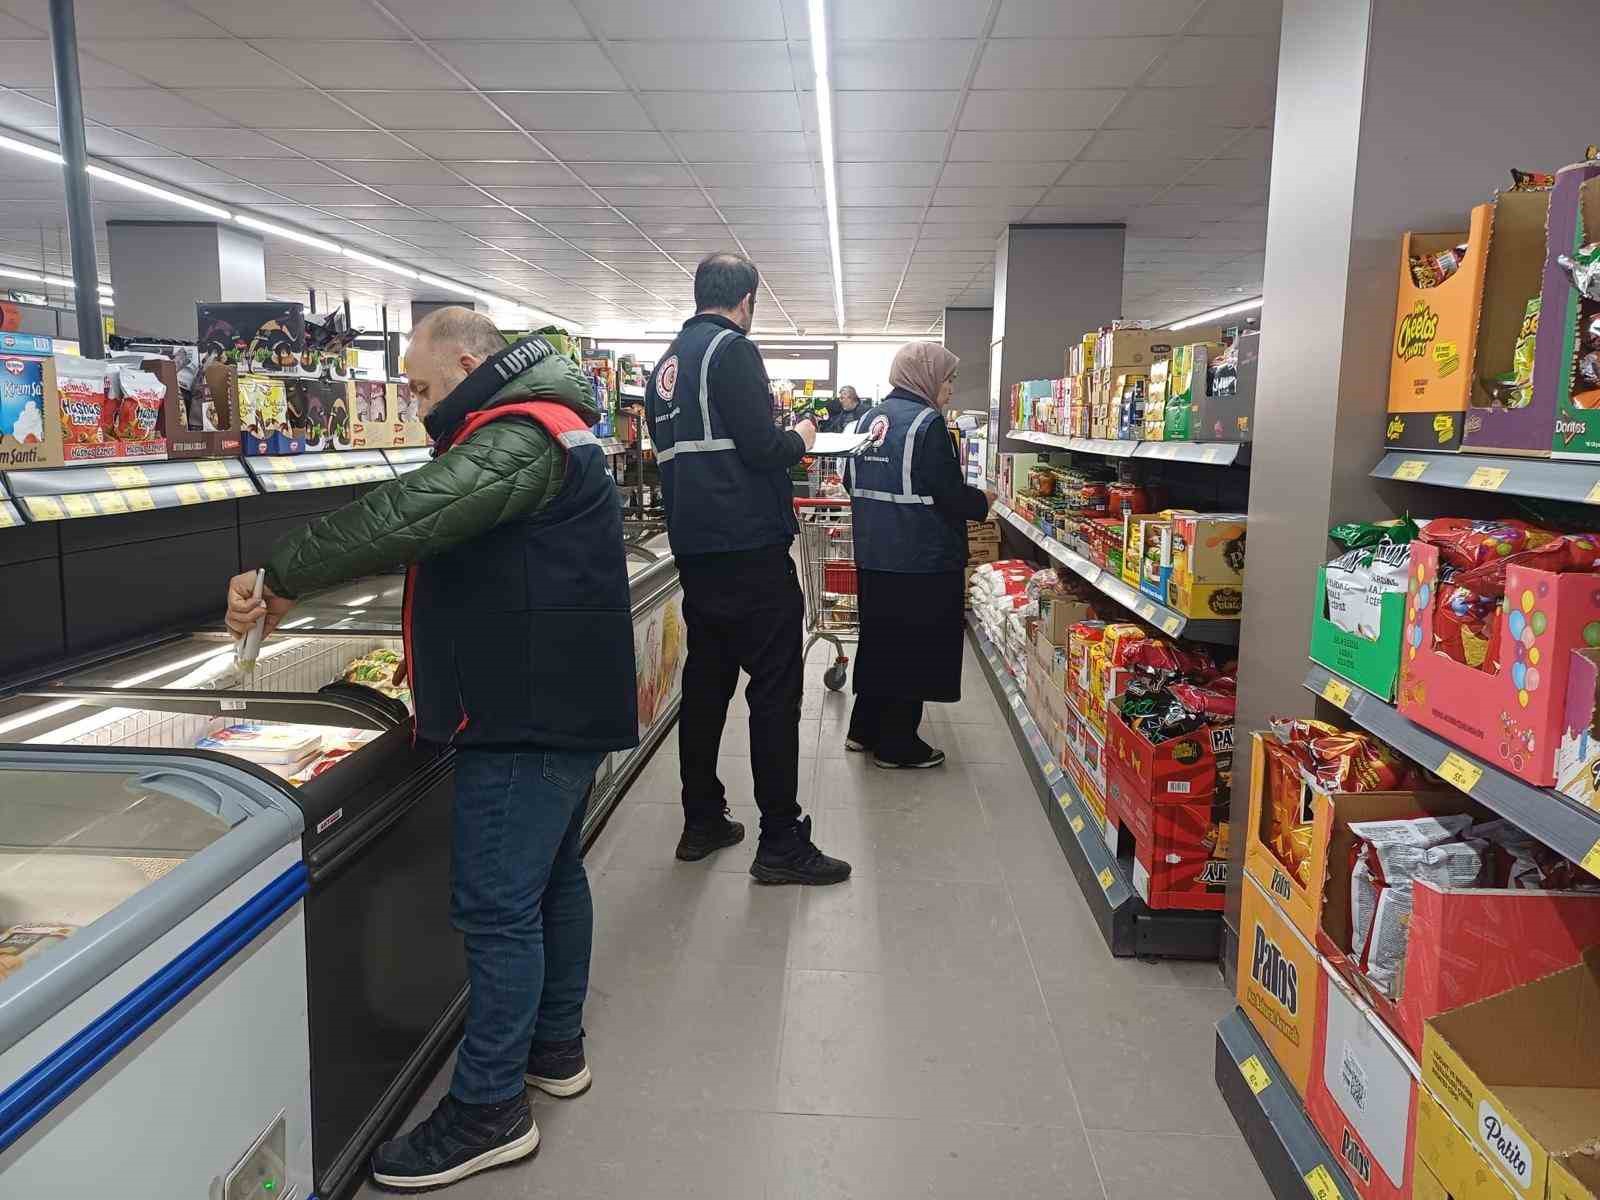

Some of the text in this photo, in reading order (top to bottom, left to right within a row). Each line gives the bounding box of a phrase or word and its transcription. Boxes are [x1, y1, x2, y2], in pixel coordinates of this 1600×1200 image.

[1397, 309, 1438, 358] Cheetos
[1555, 420, 1586, 434] Doritos
[1212, 729, 1233, 752] PA
[1484, 1116, 1526, 1176] Patito
